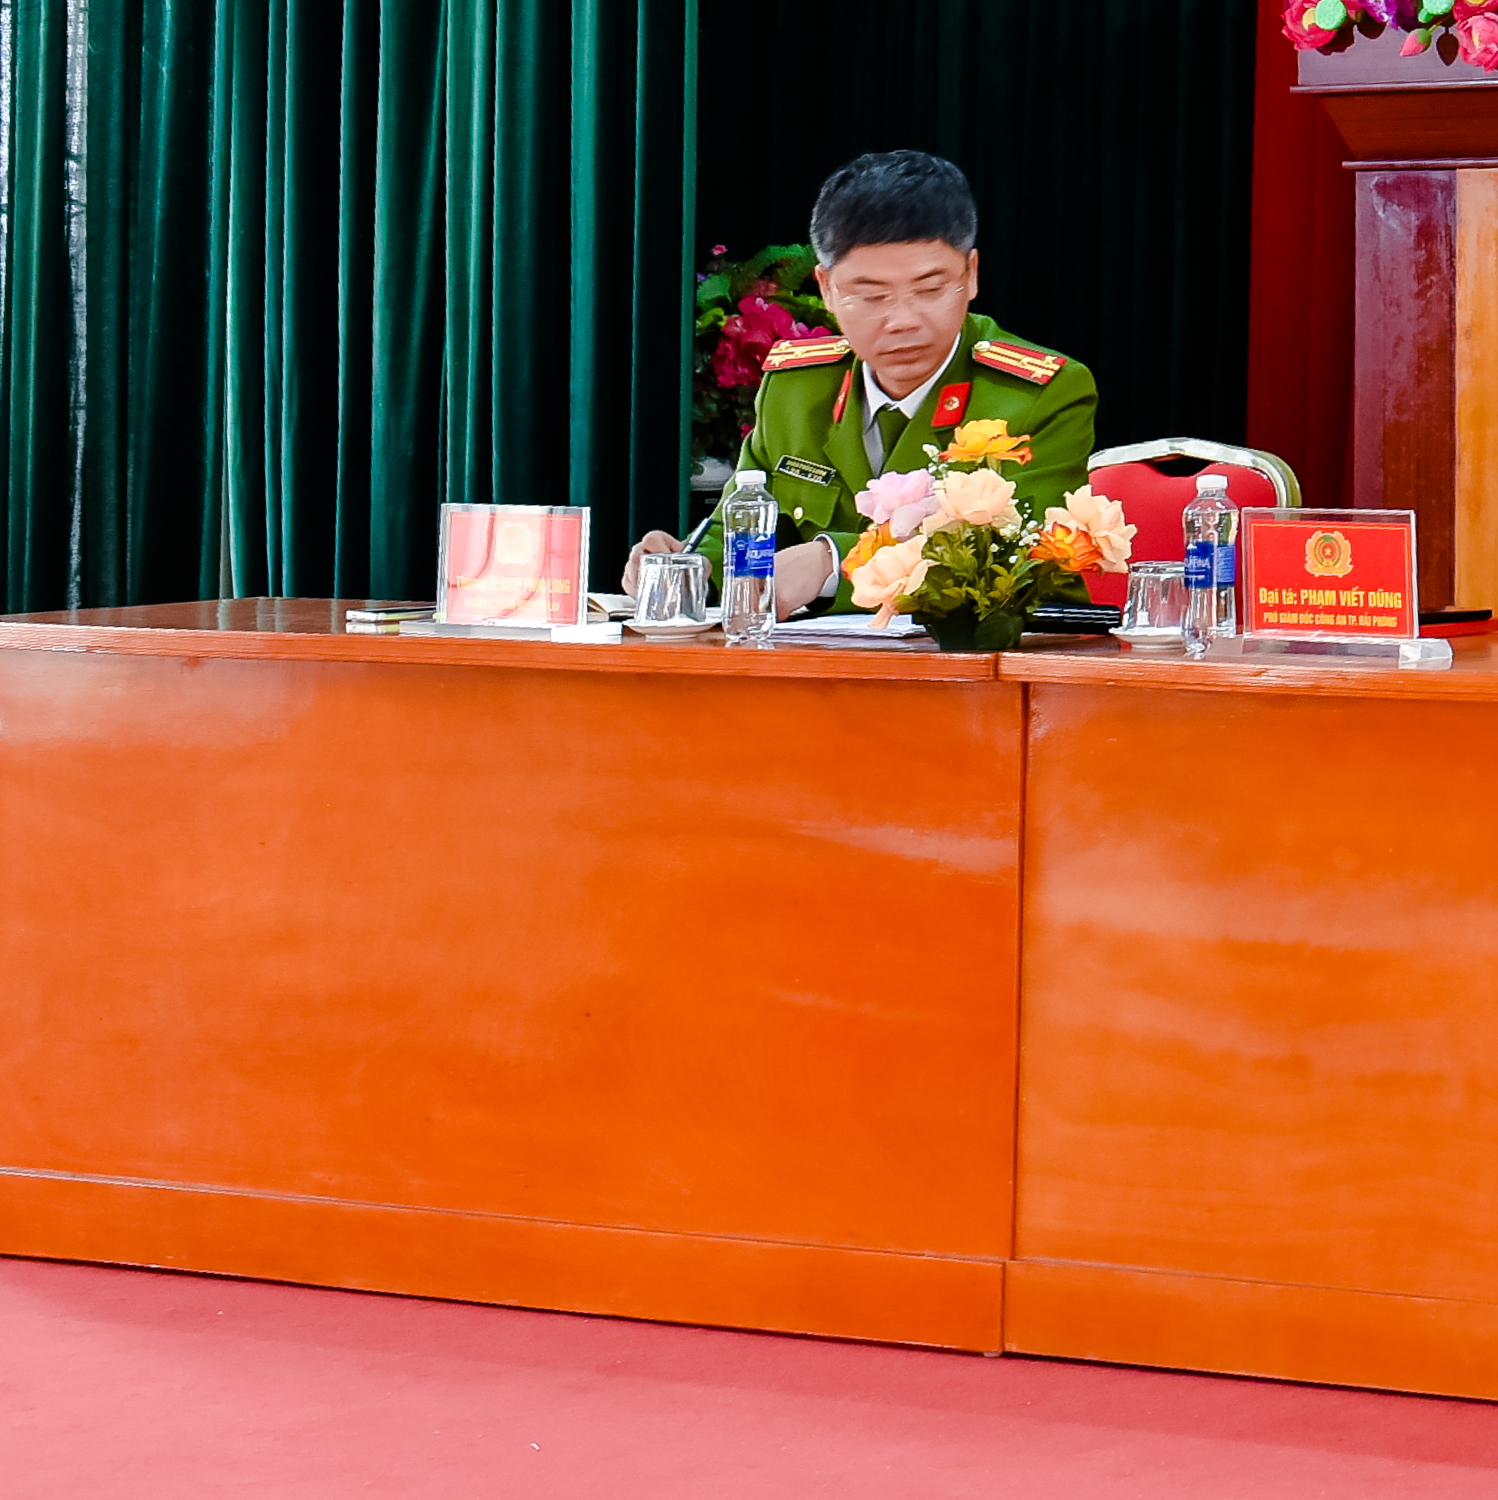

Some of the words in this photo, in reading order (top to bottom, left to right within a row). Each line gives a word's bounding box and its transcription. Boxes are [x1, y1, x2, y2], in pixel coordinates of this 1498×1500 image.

[1300, 589, 1337, 609] PHẠM
[1340, 586, 1365, 607] VIẾT
[1368, 588, 1402, 609] DŨNG
